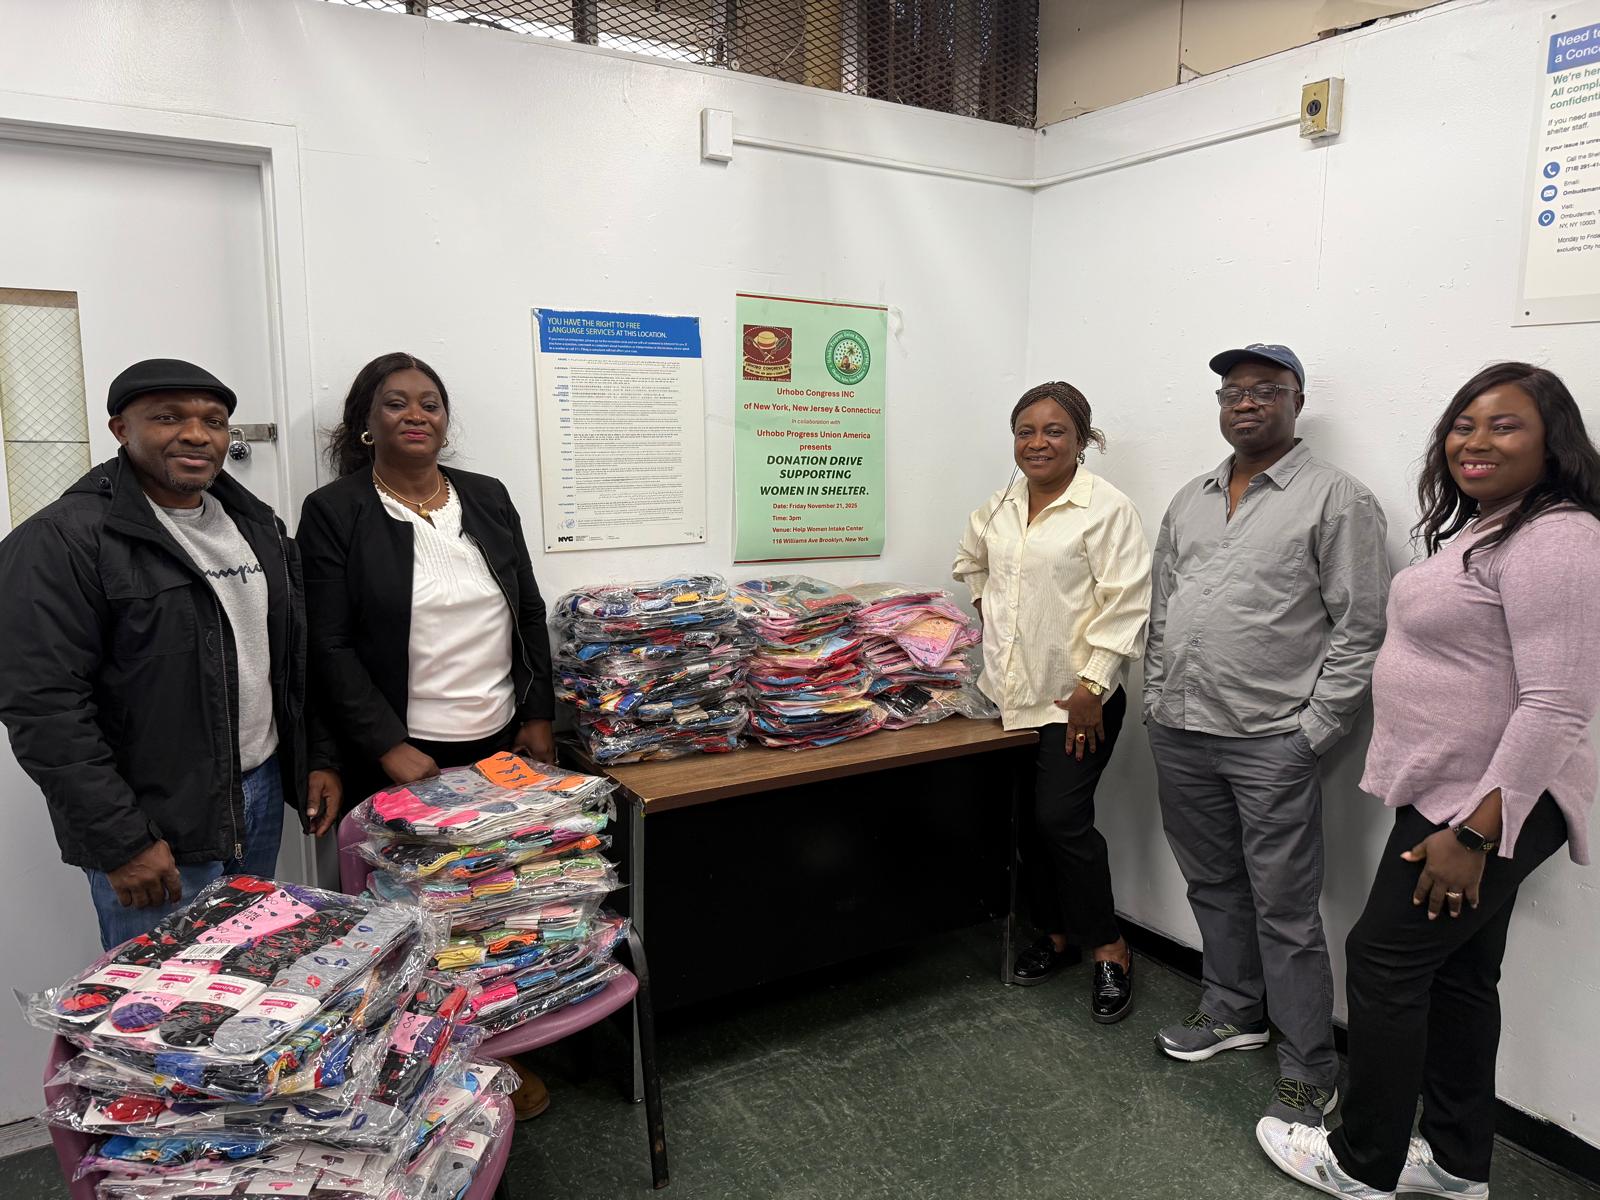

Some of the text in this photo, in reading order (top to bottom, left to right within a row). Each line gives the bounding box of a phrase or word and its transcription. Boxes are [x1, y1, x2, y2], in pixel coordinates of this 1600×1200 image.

[1556, 30, 1590, 48] Need
[1554, 45, 1600, 63] a Conc
[1553, 72, 1581, 85] We're
[1551, 78, 1600, 98] All compl
[1554, 118, 1567, 126] you
[1569, 112, 1587, 122] need
[547, 317, 641, 330] YOU HAVE THE RIGHT TO FREE
[547, 326, 585, 335] LANGUAGE
[585, 327, 615, 336] SERVICES
[637, 330, 668, 339] LOCATION.
[776, 387, 855, 399] Urhobo Congress INC
[743, 402, 881, 415] of New York, New Jersey & Connecticut
[756, 429, 871, 439] Urhobo Progress Union America
[799, 443, 832, 452] presents
[766, 455, 864, 466] DONATION DRIVE
[779, 469, 852, 479] SUPPORTING
[760, 486, 870, 496] WOMEN IN SHELTER.
